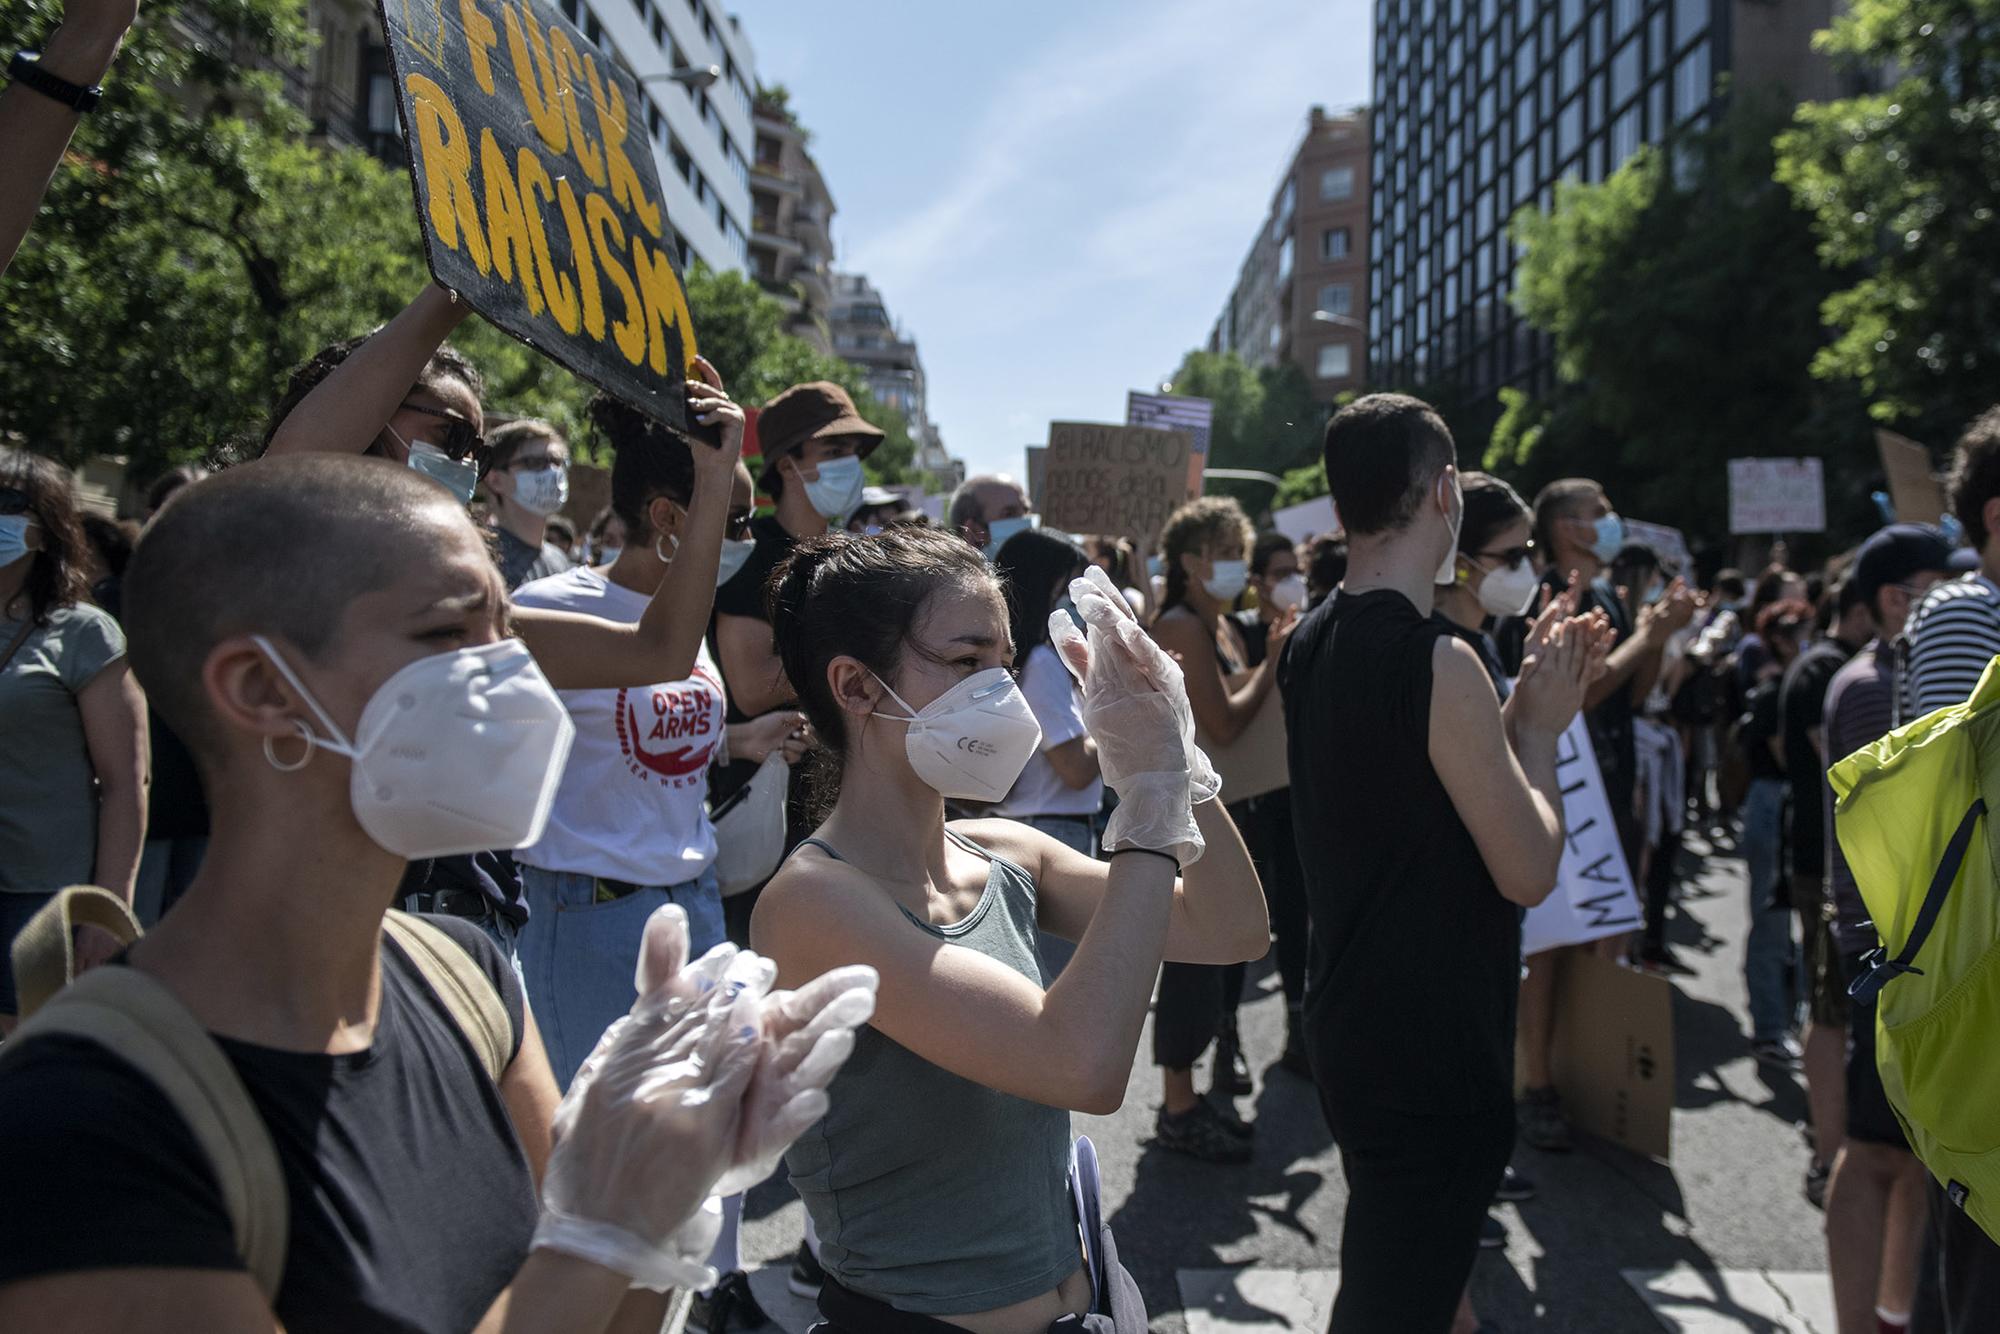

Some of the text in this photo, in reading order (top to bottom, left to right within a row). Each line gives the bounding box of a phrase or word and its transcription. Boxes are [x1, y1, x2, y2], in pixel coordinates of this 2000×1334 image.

[460, 0, 662, 239] FUCK
[406, 72, 703, 381] RACISM
[652, 688, 712, 716] OPEN
[648, 713, 711, 740] ARMS
[956, 736, 979, 753] CE
